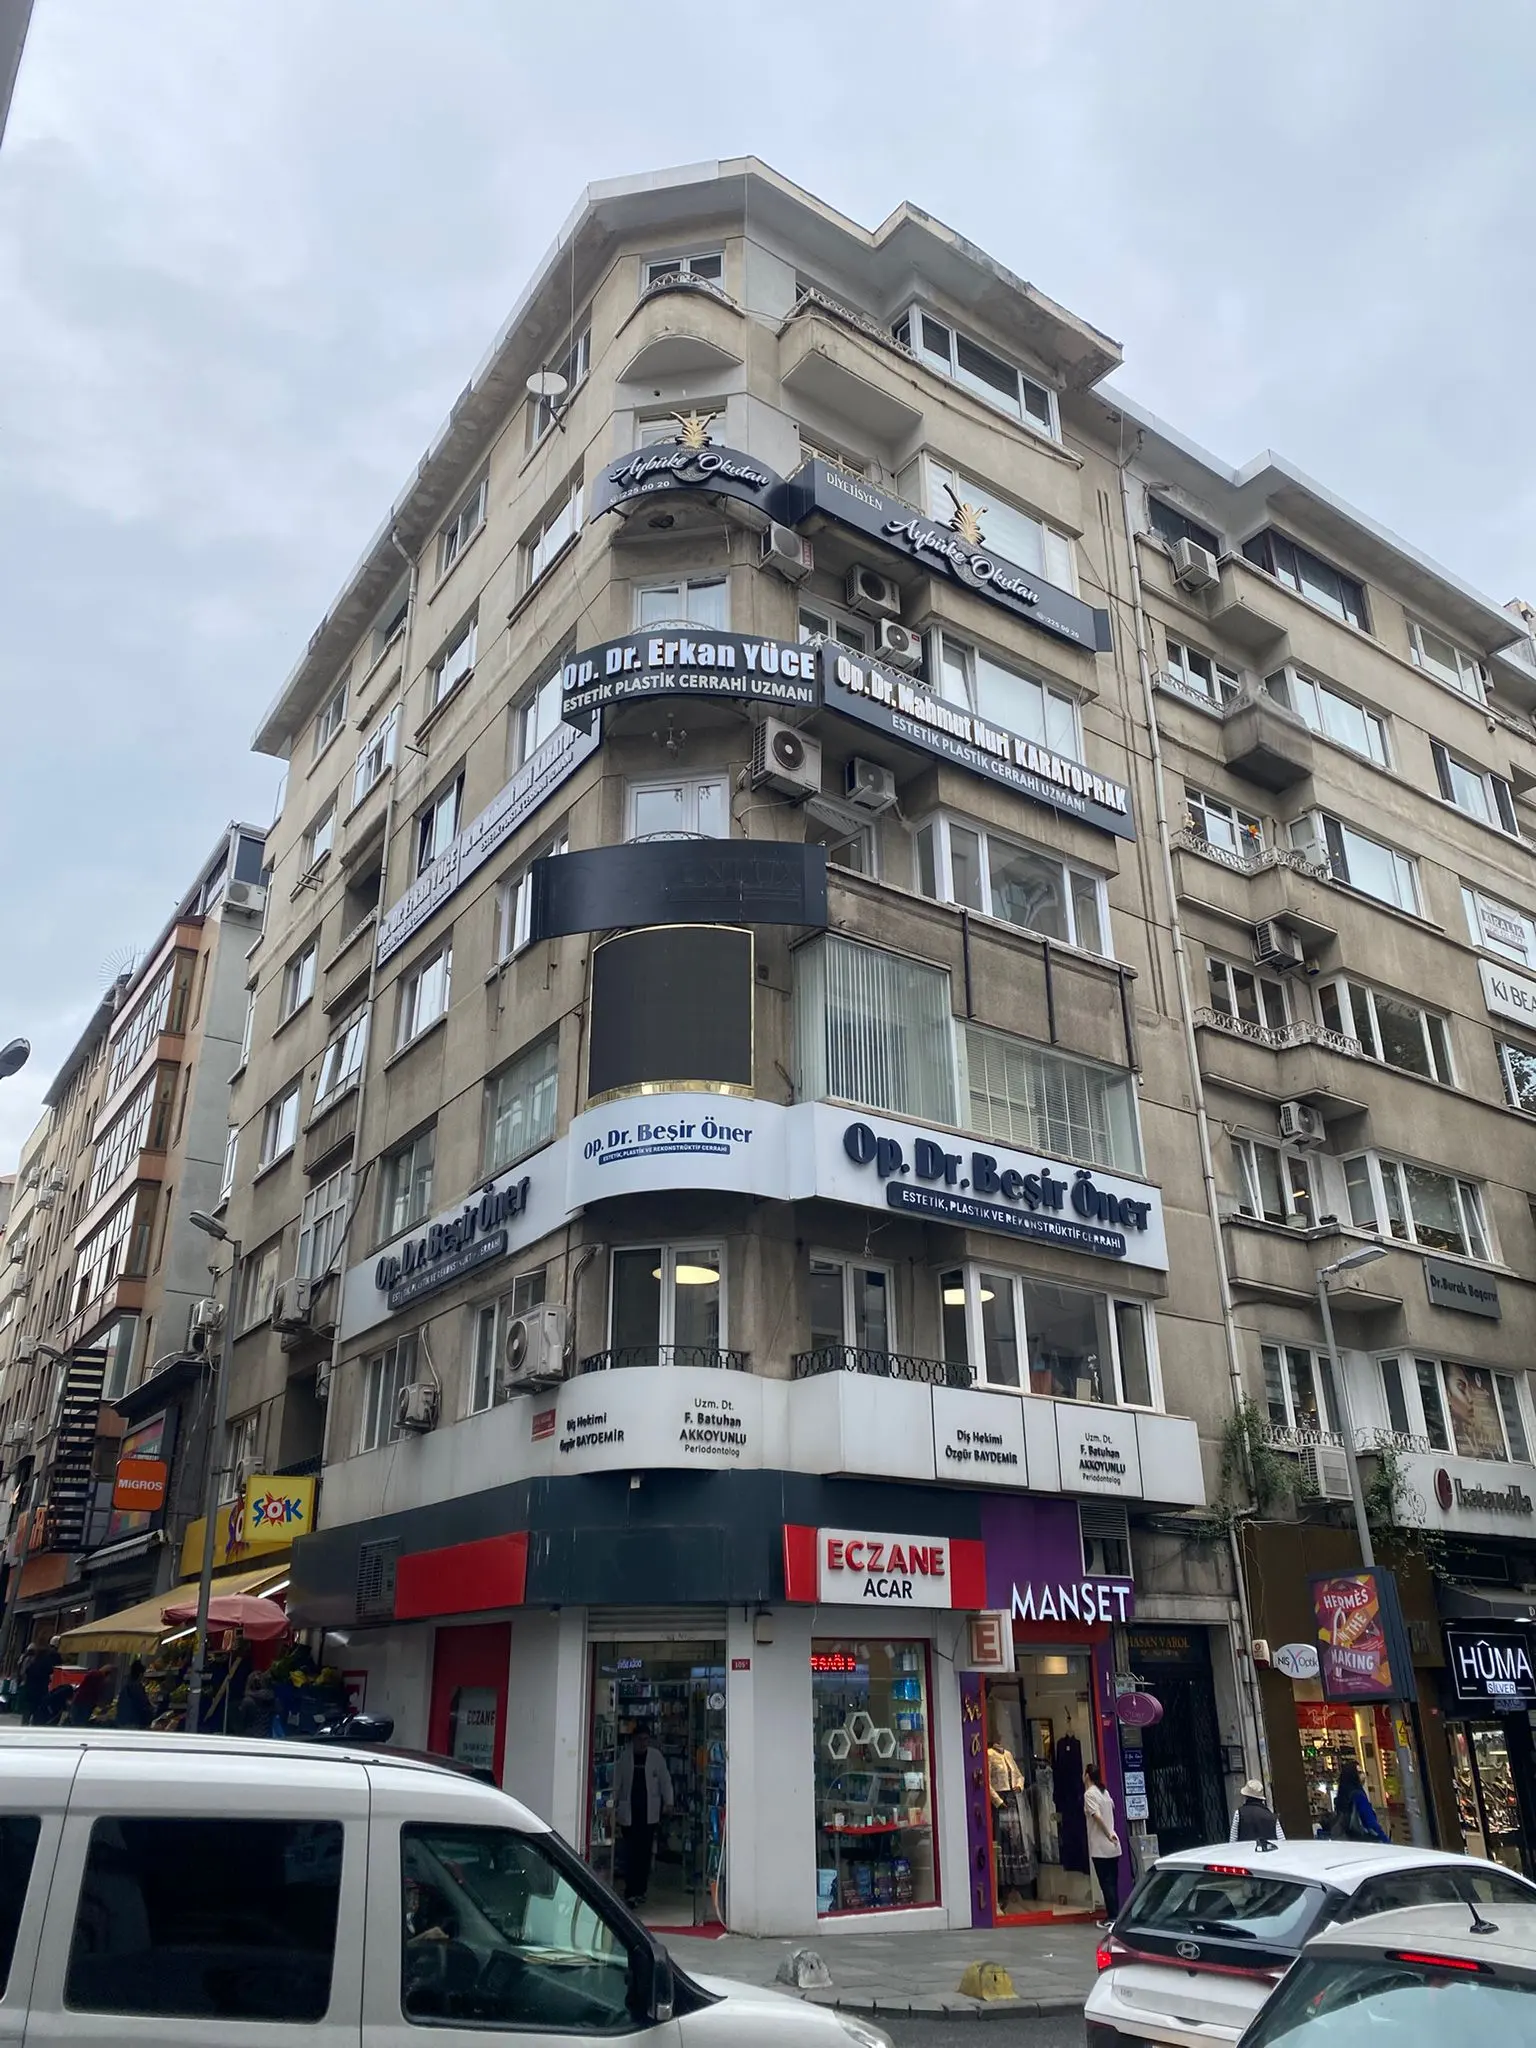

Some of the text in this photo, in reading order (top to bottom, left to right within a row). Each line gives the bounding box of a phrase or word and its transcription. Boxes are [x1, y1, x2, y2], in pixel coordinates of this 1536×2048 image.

[609, 452, 770, 487] Aybüke Okutan
[657, 480, 670, 488] 20
[826, 471, 882, 511] DİYETİSYEN
[969, 554, 1040, 604] Okutan
[563, 638, 816, 690] Op. Dr. Erkan YÜCE
[563, 672, 813, 713] ESTETİK PLASTİK CERRAHİ UZMANI
[897, 682, 973, 742] Mahmut
[973, 719, 1010, 760] Nuri
[1014, 738, 1128, 816] KARATOPRAK
[892, 714, 1086, 814] ESTETİK PLASTİK CERRAHİ UZMANI
[584, 1116, 753, 1160] Op. Dr. Beşir Öner
[972, 1151, 1068, 1211] Beşir
[1071, 1170, 1152, 1231] Öner
[426, 1205, 479, 1261] Beşir
[477, 1176, 531, 1232] Öner
[949, 1201, 990, 1219] PLASTİK
[991, 1211, 1005, 1223] VE
[1005, 1213, 1081, 1240] REKONSTRÜKTİF
[694, 1398, 735, 1411] Uzm. Dt.
[577, 1412, 608, 1428] Hekimi
[684, 1412, 742, 1428] F. Batuhan
[576, 1429, 625, 1447] BAYDEMİR
[679, 1429, 747, 1445] AKKOYUNLU
[956, 1429, 1003, 1445] Diş Hekimi
[1085, 1432, 1113, 1445] Uzm. Dt.
[684, 1444, 741, 1458] Periodontolog
[945, 1446, 1018, 1465] Özgür BAYDEMİR
[1080, 1445, 1120, 1459] F. Batuhan
[1079, 1458, 1127, 1474] AKKOYUNLU
[1082, 1473, 1122, 1486] Periodontolog
[252, 1498, 304, 1528] ŞOK
[827, 1538, 946, 1576] ECZANE
[863, 1578, 914, 1600] ACAR
[1012, 1582, 1131, 1626] MANŞET
[1346, 1612, 1368, 1637] THE
[1331, 1648, 1374, 1670] MAKING
[1459, 1640, 1534, 1680] HÛMA
